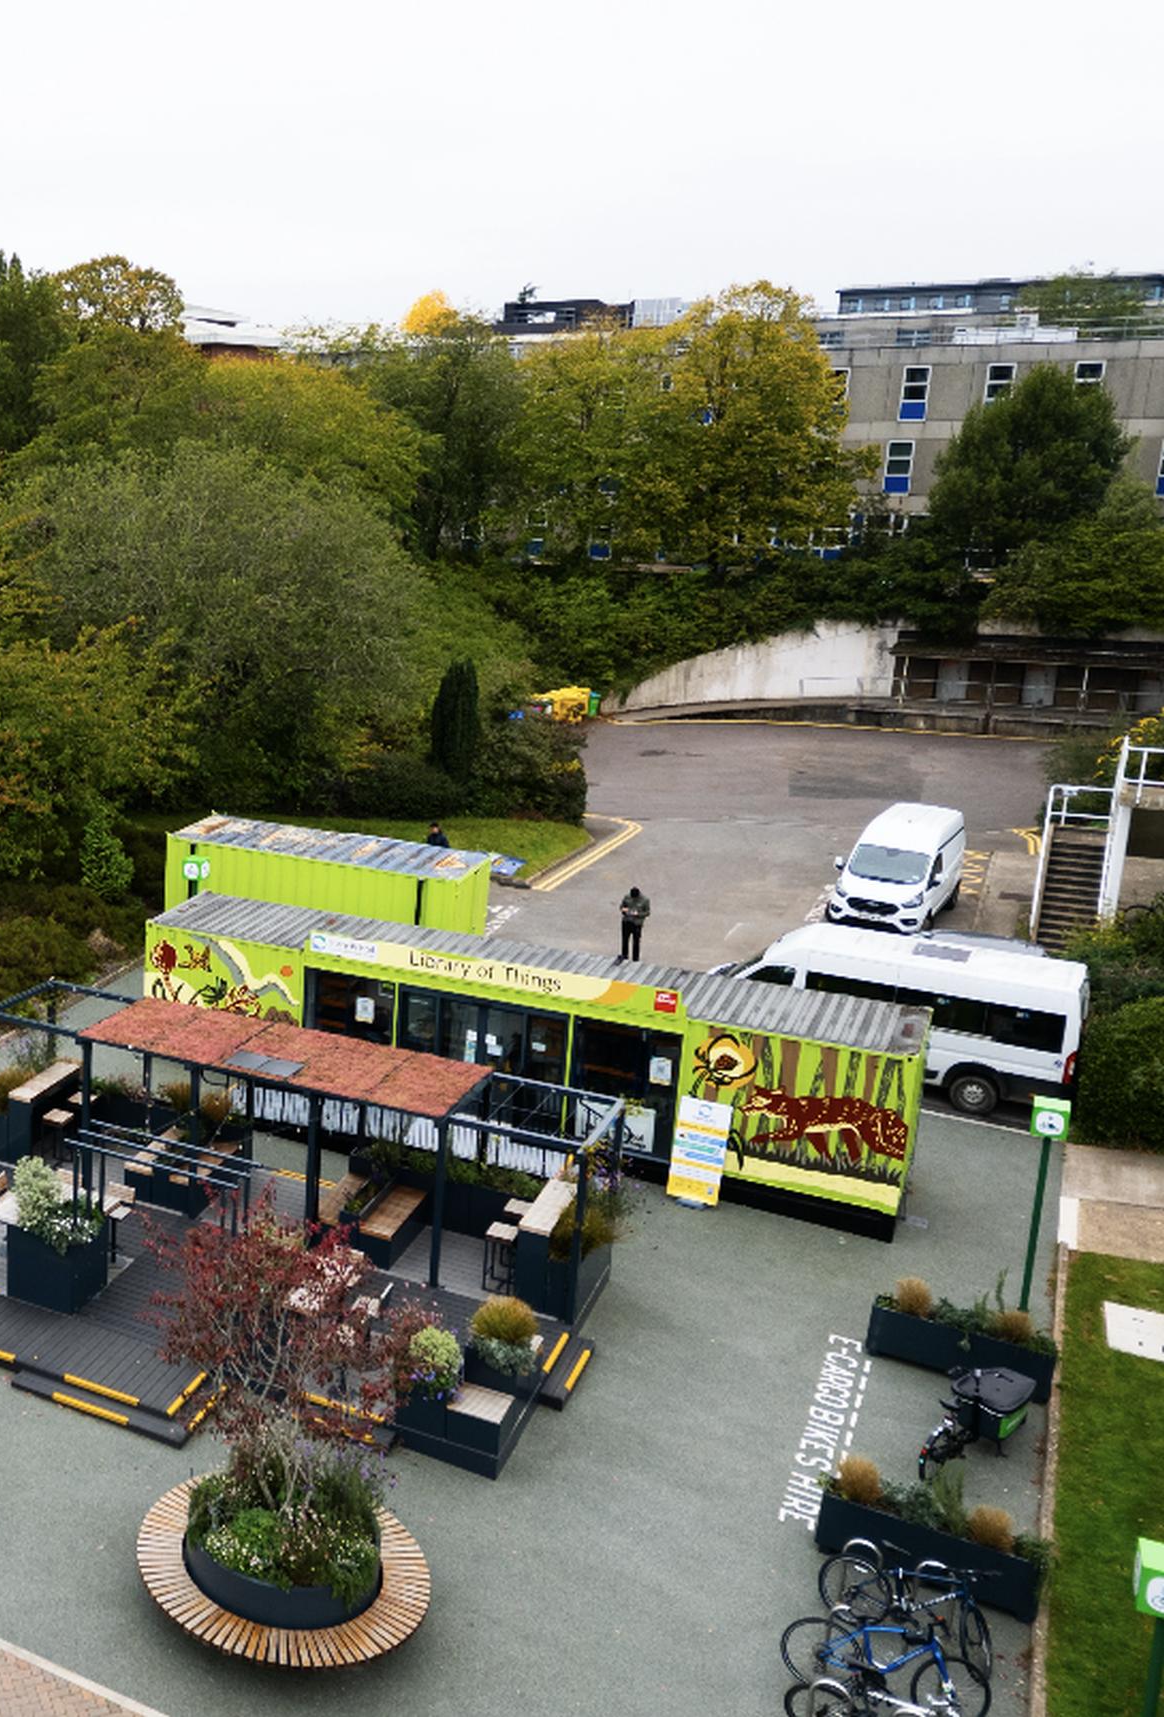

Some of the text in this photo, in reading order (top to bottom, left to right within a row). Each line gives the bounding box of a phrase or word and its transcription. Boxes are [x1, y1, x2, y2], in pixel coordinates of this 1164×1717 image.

[408, 950, 562, 994] Library of Things
[777, 1333, 863, 1531] E-CARGO BIKES HIRE
